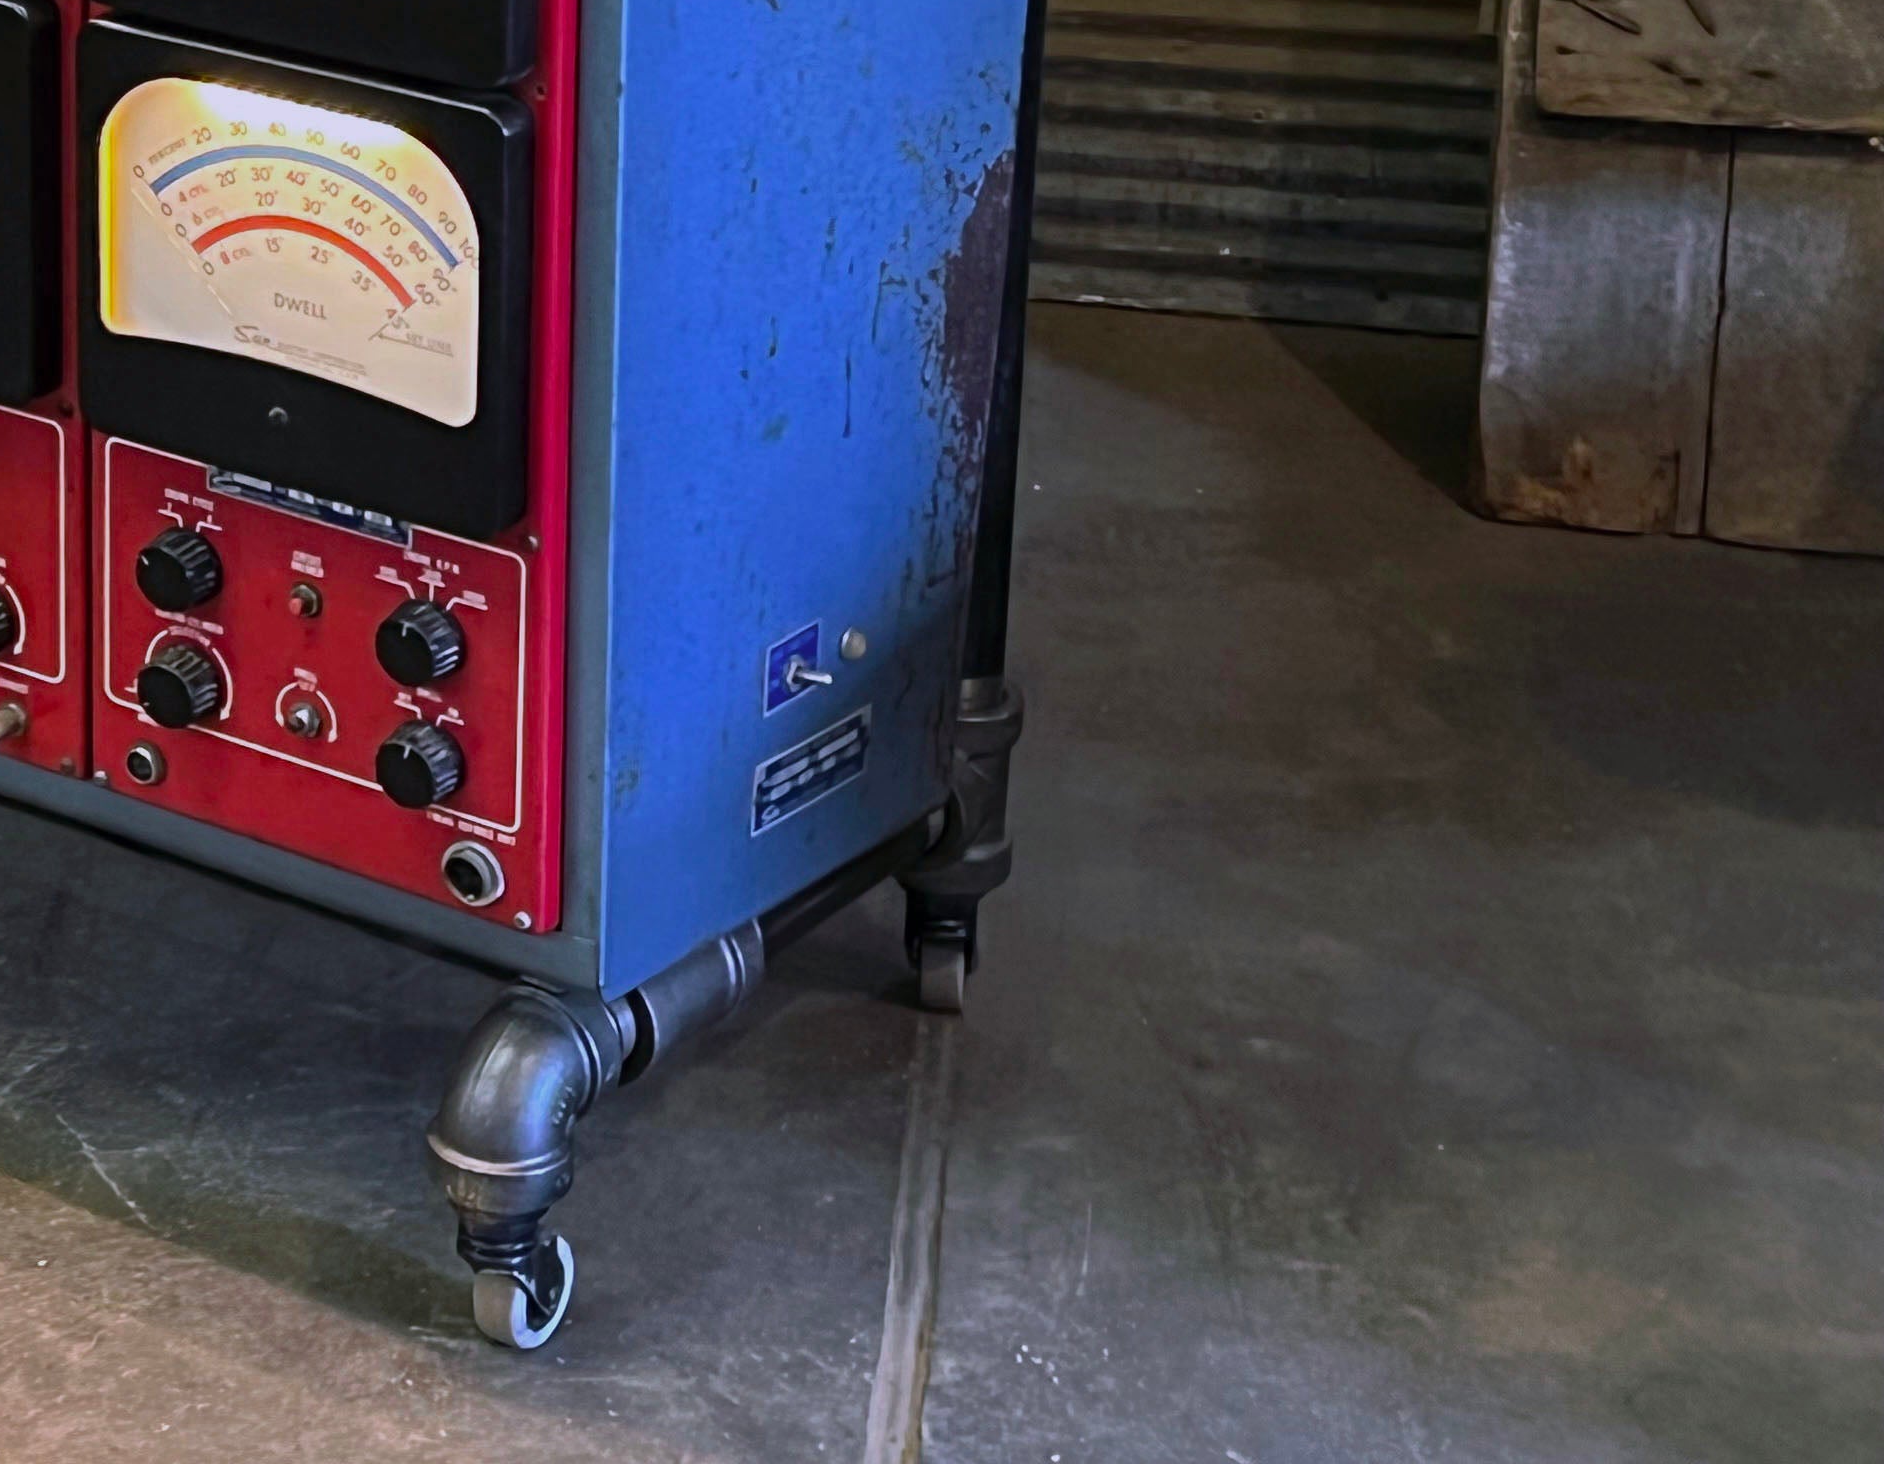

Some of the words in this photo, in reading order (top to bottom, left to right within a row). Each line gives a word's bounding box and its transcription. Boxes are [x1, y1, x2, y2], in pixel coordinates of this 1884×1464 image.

[132, 164, 145, 179] 0
[190, 126, 212, 145] 20
[229, 120, 248, 136] 30
[339, 140, 362, 161] 60
[374, 159, 397, 182] 70
[407, 183, 429, 206] 80
[273, 291, 328, 320] DWELL
